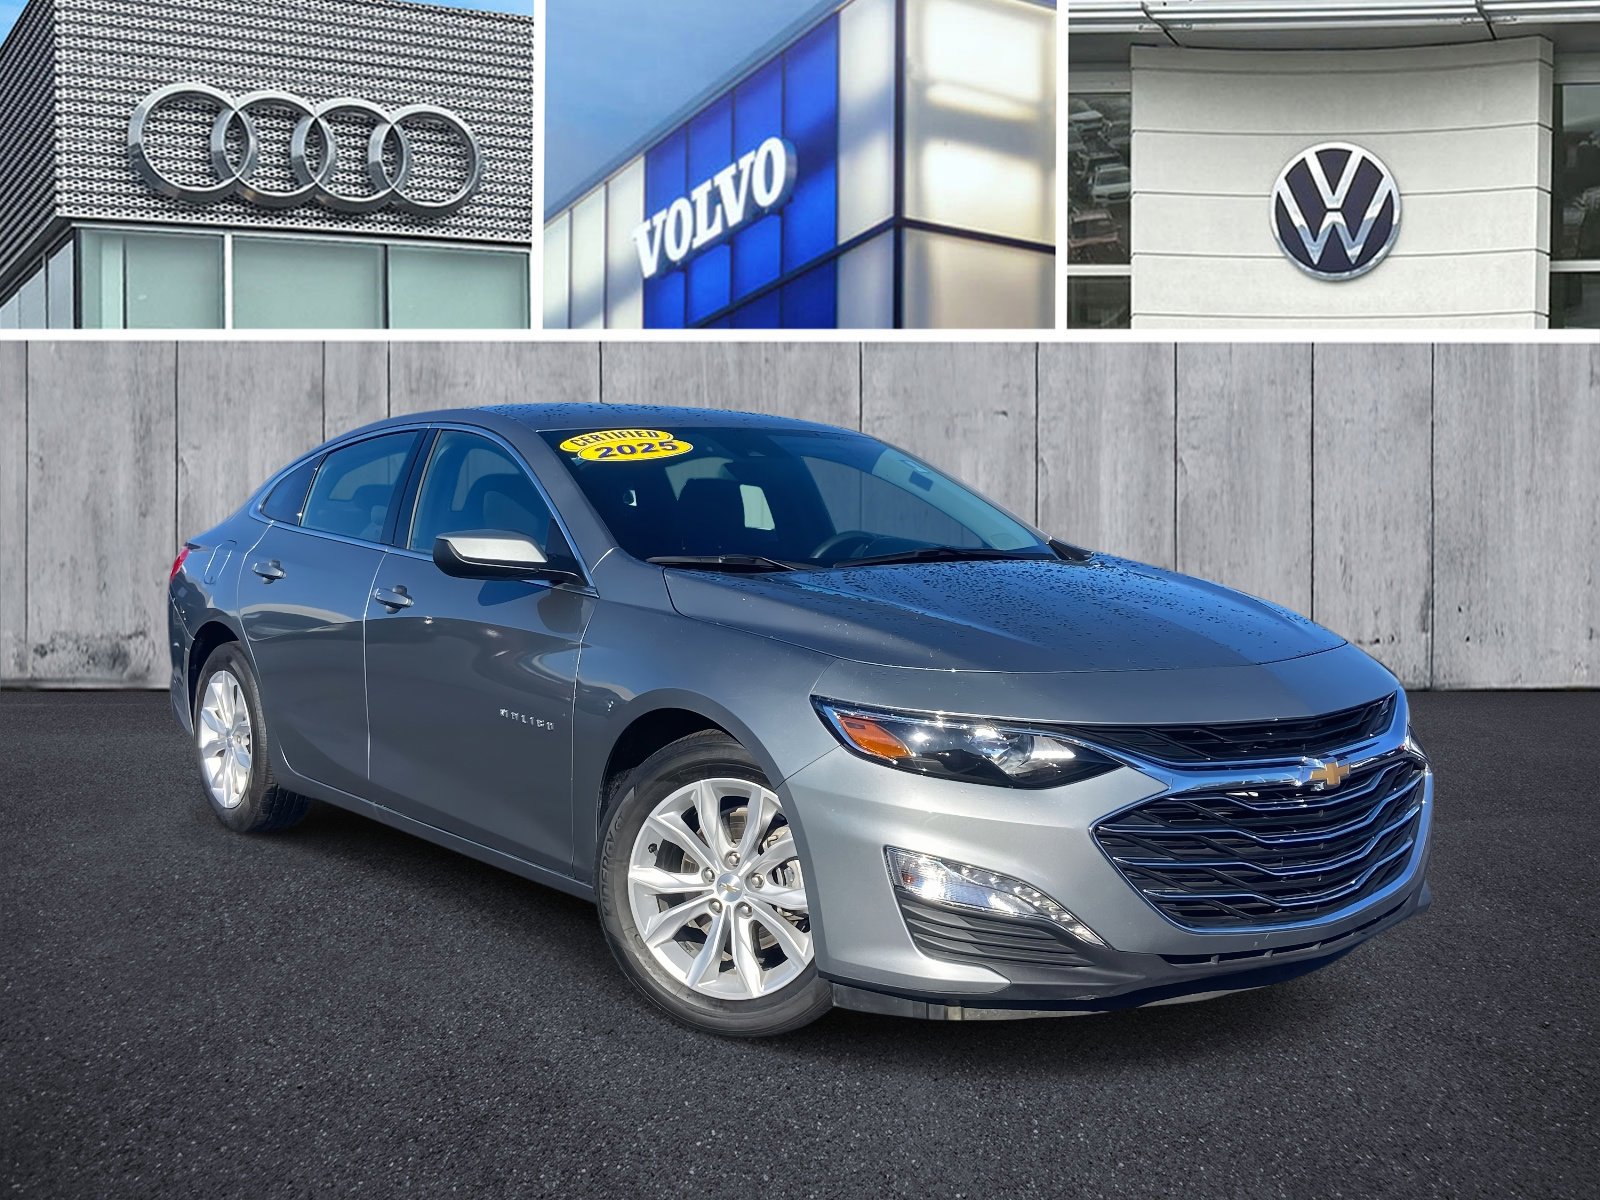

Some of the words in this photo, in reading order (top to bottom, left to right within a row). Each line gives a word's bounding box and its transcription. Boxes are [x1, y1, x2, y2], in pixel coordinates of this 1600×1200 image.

[632, 136, 789, 279] VOLVO
[569, 429, 661, 447] CERTIFIED
[594, 440, 680, 459] 2025
